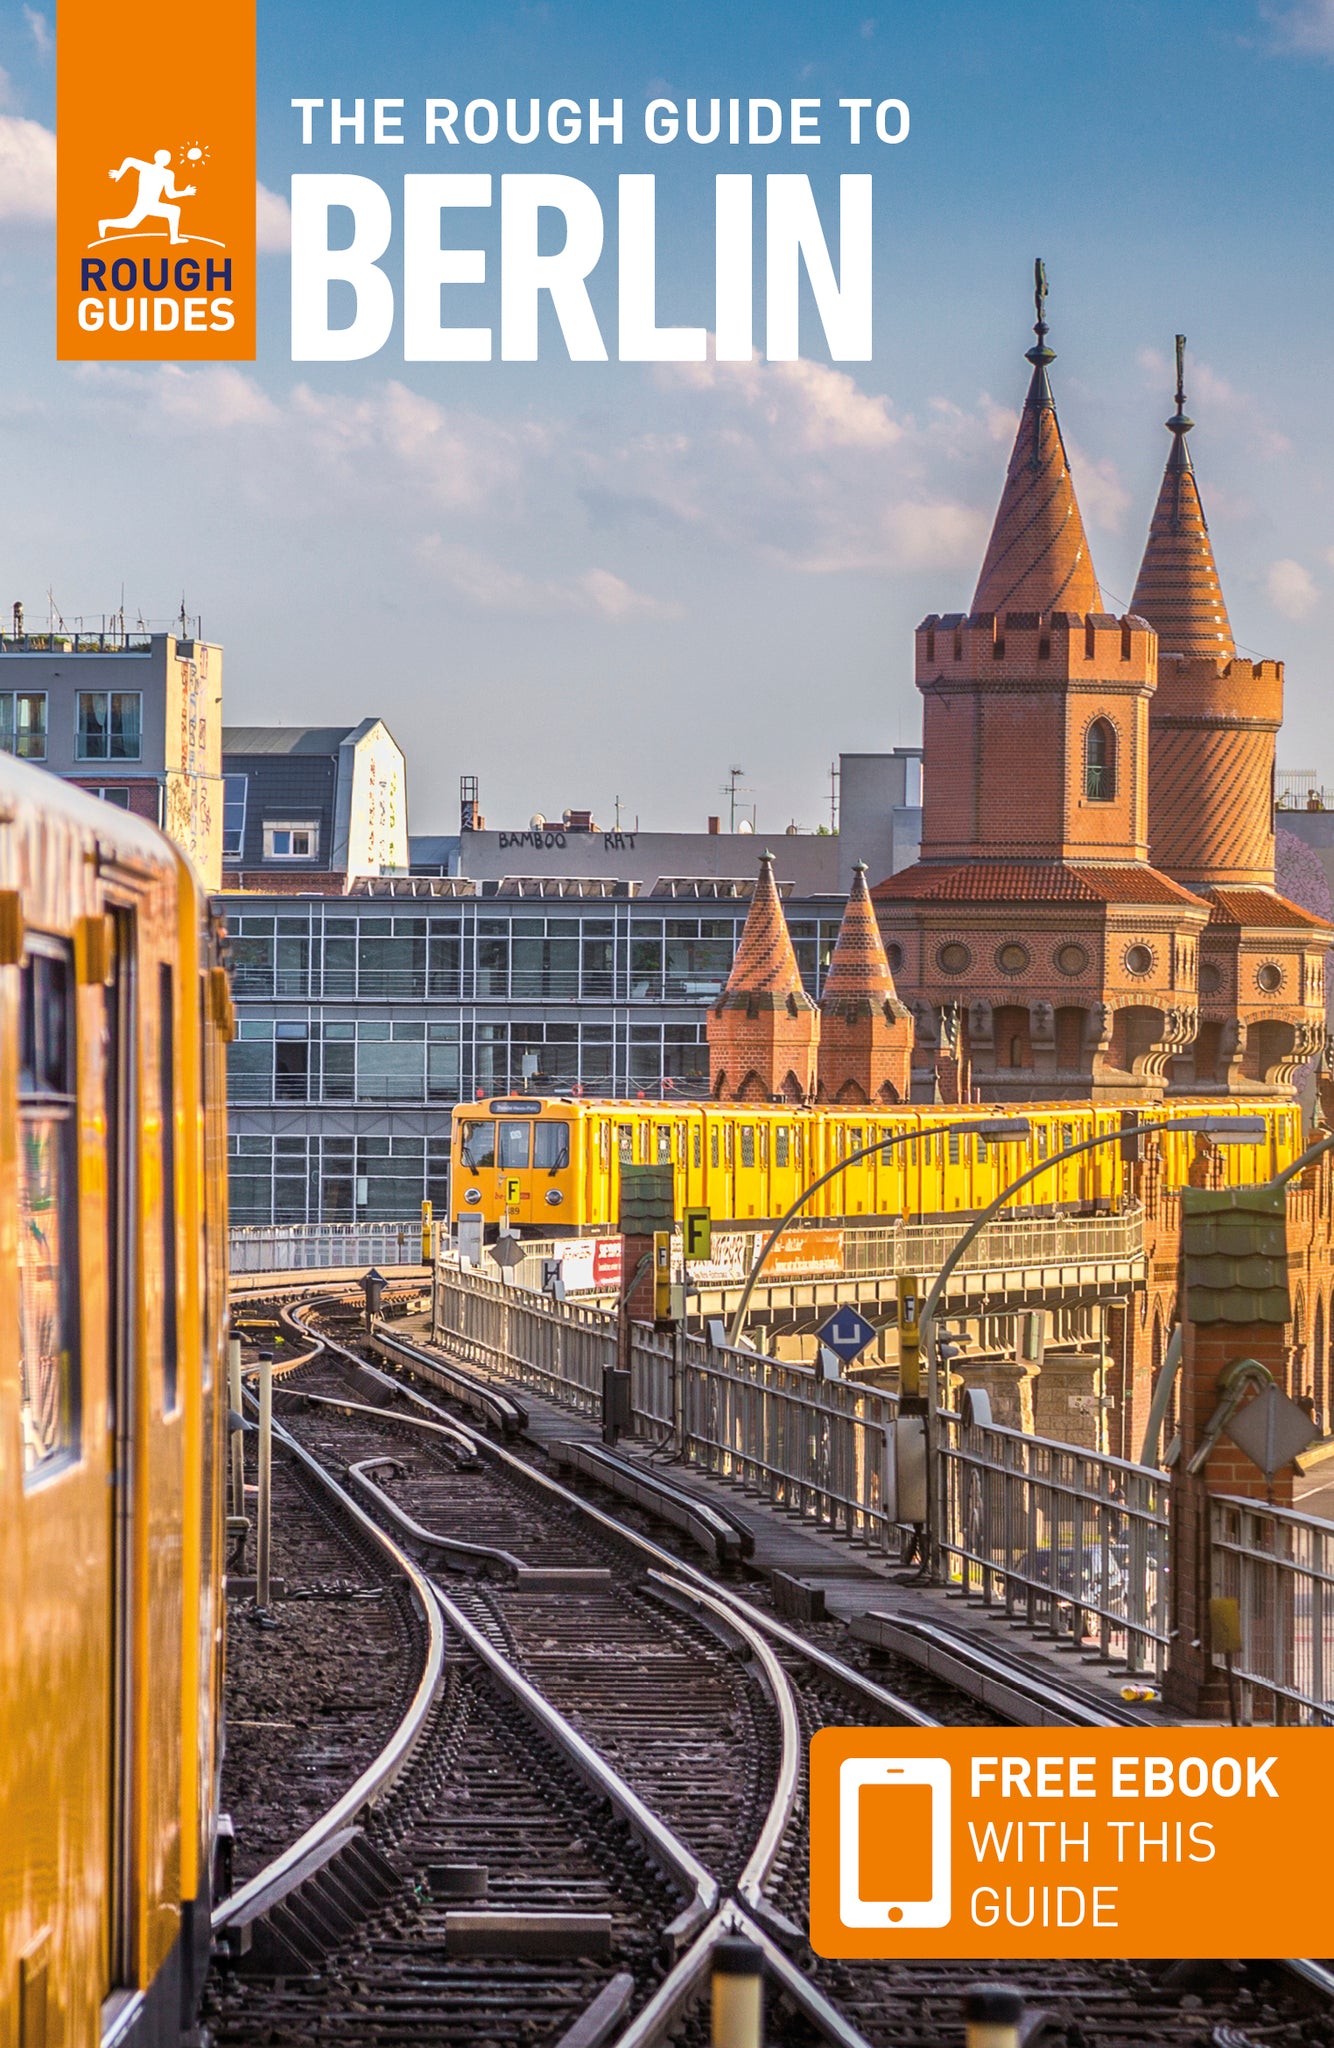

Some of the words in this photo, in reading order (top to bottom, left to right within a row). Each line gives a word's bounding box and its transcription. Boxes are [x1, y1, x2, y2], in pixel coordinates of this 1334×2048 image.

[499, 832, 567, 849] BAMBOO
[604, 832, 637, 850] RAT
[508, 1181, 518, 1200] F
[688, 1214, 707, 1254] F
